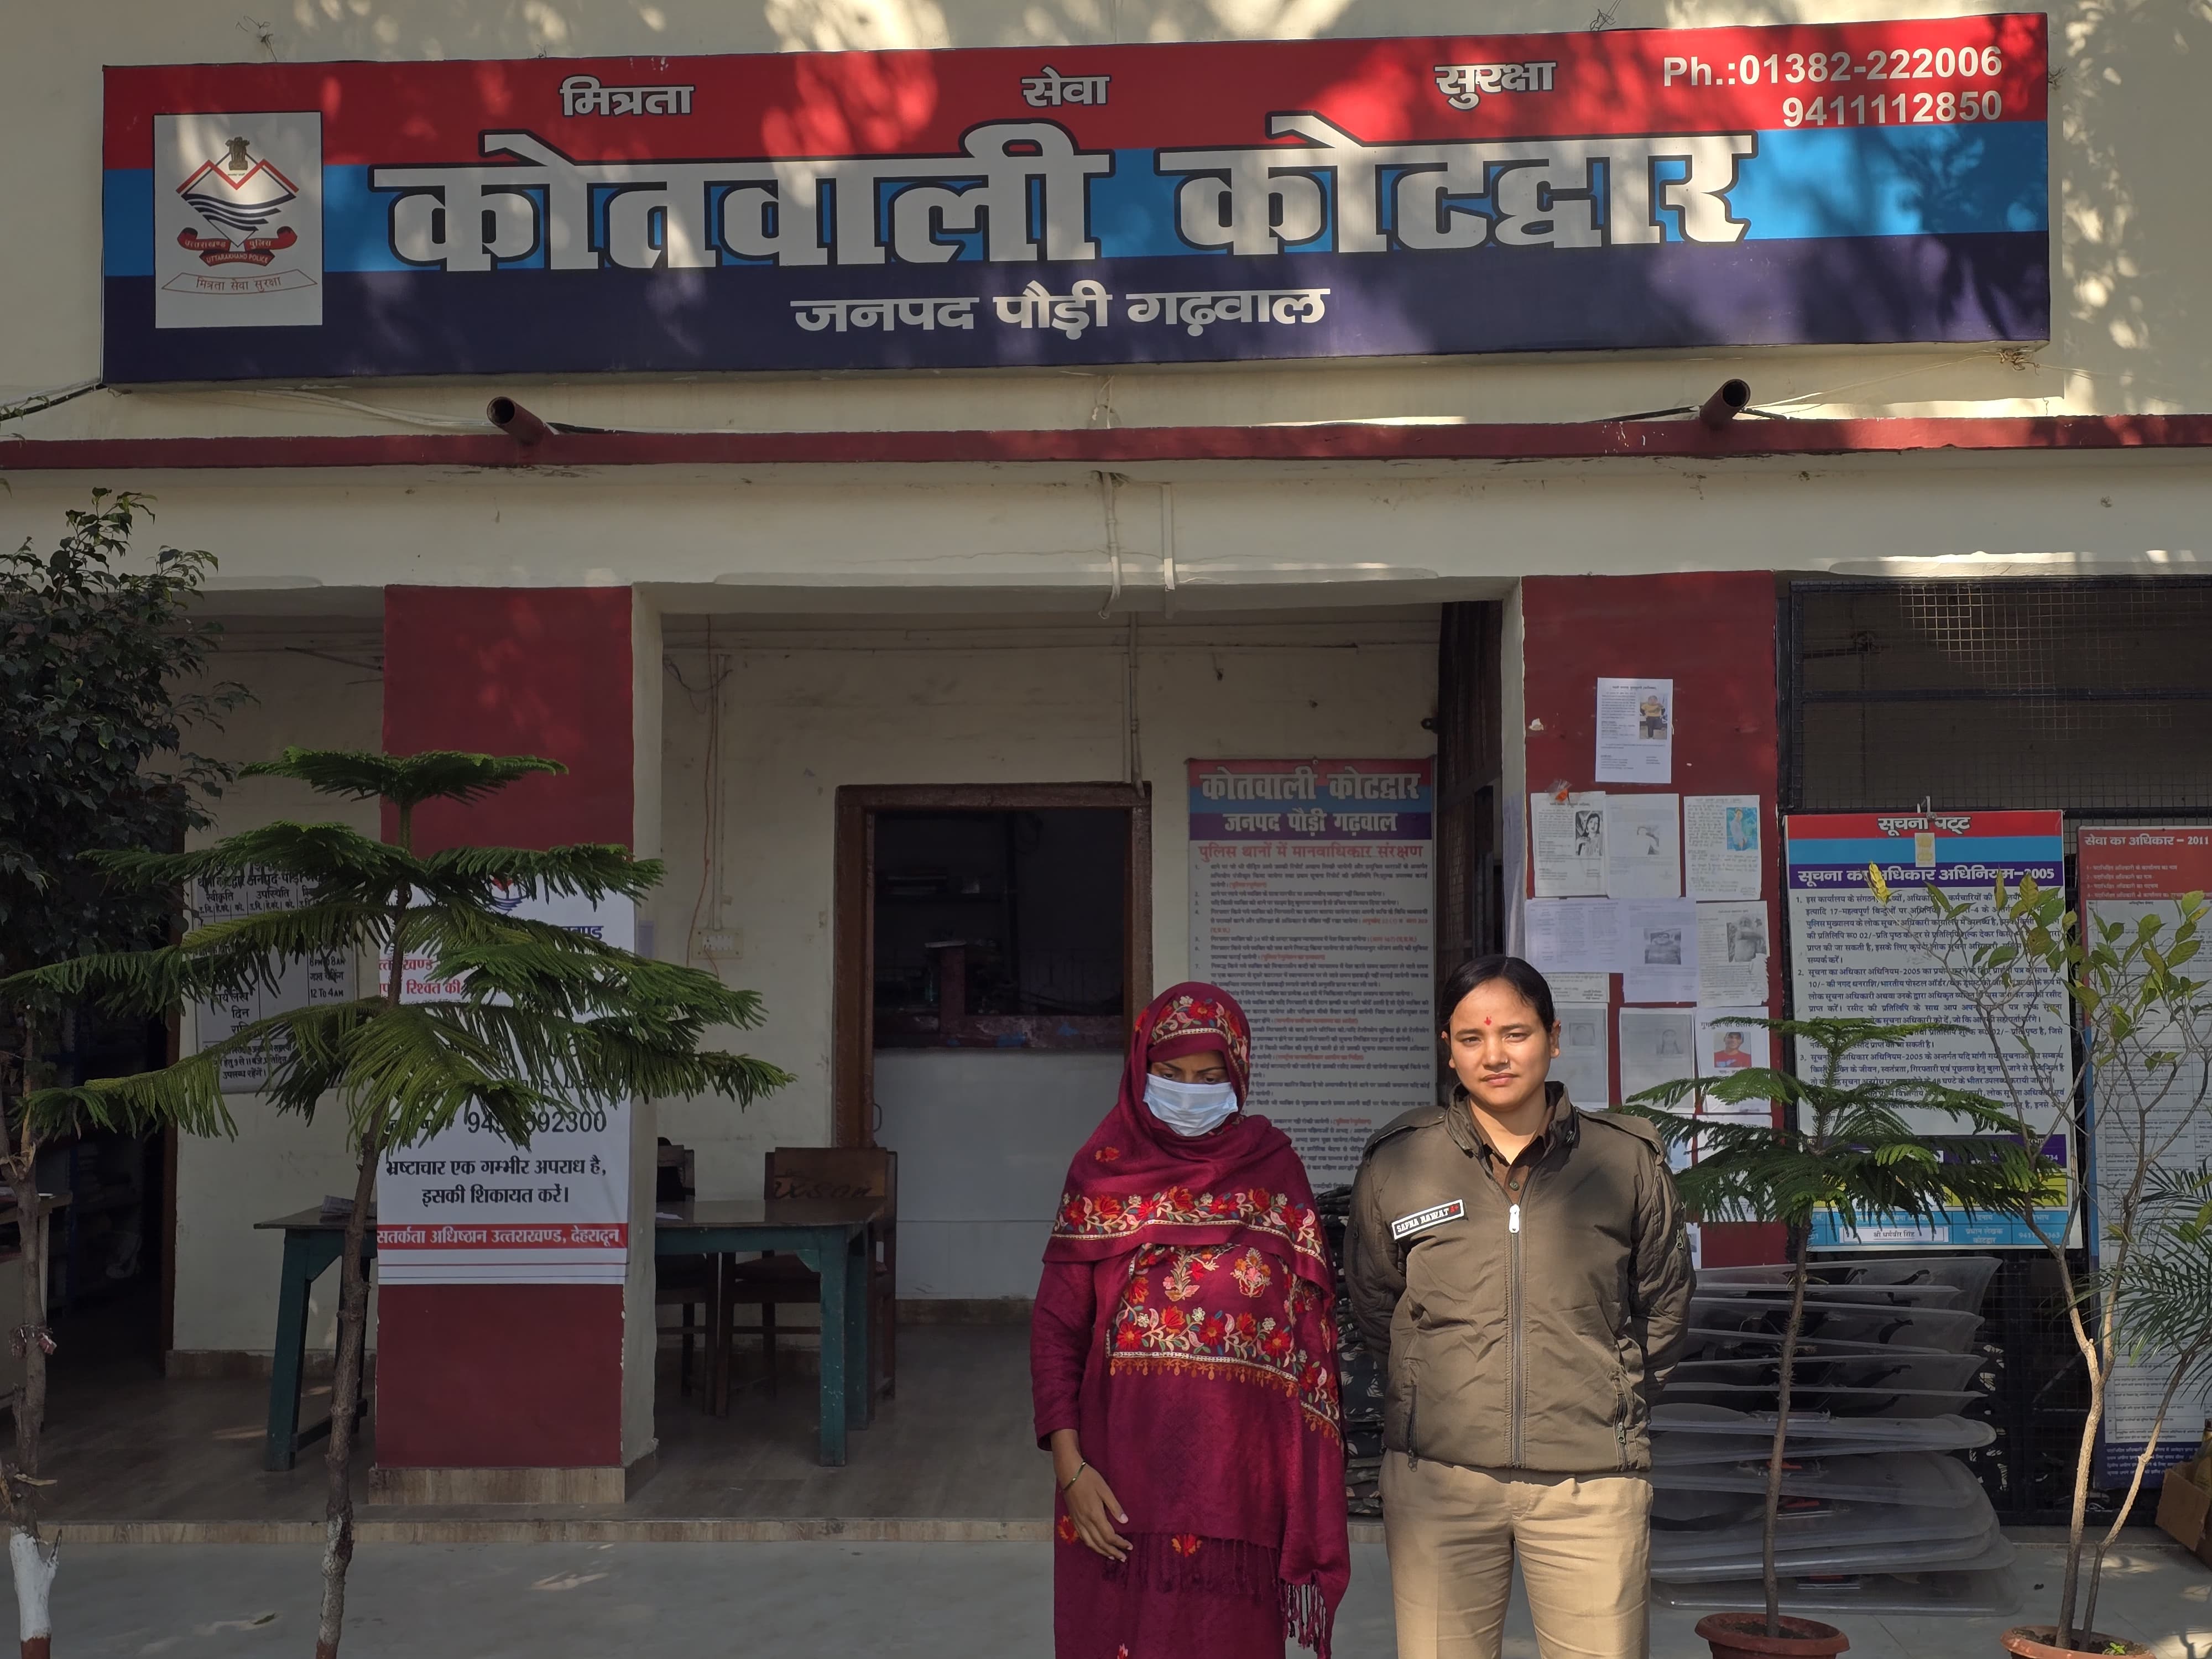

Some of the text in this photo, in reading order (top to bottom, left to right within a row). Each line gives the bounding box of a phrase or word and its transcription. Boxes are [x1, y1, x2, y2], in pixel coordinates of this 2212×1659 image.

[1663, 46, 2002, 87] Ph.:01382-222006
[1022, 68, 1109, 107] सेवा
[1436, 60, 1556, 109] सुरक्षा
[561, 76, 695, 115] मित्रता
[1782, 90, 2002, 127] 9411112850
[374, 114, 1756, 271] कोतवाली कोटद्वार
[249, 253, 269, 263] POLICE
[196, 277, 281, 292] मित्रता सेवा सुरक्षा
[791, 279, 1330, 340] जनपद पौड़ी गढ़वाल
[1199, 766, 1421, 800] कोतवाली कोटद्वार
[1223, 807, 1399, 837] जनपद पौड़ी गढ़वाल
[1878, 817, 1928, 836] सूचना
[2084, 833, 2209, 846] सेवा का अधिकार 2011
[1198, 841, 1424, 862] पुलिस थानों में मानवाधिकार संरक्षण
[1798, 870, 1842, 888] सूचना
[1805, 896, 1816, 905] इस
[1817, 894, 1846, 903] कार्यालय
[1847, 894, 1855, 902] के
[1948, 892, 1982, 901] कर्मचारियों
[1983, 892, 1992, 901] की
[1806, 907, 1827, 916] इत्यादि
[1806, 919, 1825, 928] पुलिस
[1827, 920, 1854, 928] मुख्यालय
[1864, 919, 1880, 927] लोक
[1806, 930, 1816, 939] की
[1817, 930, 1844, 939] प्रतिलिपि
[1979, 930, 1994, 938] देकर
[1823, 943, 1833, 951] की
[1845, 942, 1864, 951] सकती
[1866, 942, 1874, 952] है,
[1875, 942, 1892, 952] इसके
[1894, 942, 1907, 952] लिए
[1808, 968, 1827, 977] सूचना
[1839, 967, 1866, 975] अधिकार
[1867, 967, 1921, 975] अधिनियम-2005
[406, 979, 462, 995] रिश्वत की
[1827, 979, 1836, 987] की
[311, 989, 317, 998] 12
[328, 988, 344, 998] 4AM
[1808, 992, 1824, 1000] लोक
[1825, 993, 1844, 1001] सूचना
[1845, 991, 1874, 1000] अधिकारी
[1897, 991, 1912, 999] उनके
[1913, 992, 1926, 1000] द्वारा
[1928, 992, 1954, 1001] अधिकृत
[2046, 990, 2062, 999] रसीद
[231, 1005, 250, 1019] दिन
[1808, 1004, 1823, 1013] प्राप्त
[1846, 1003, 1864, 1013] रसीद
[1867, 1003, 1877, 1012] की
[1882, 1003, 1909, 1012] प्रतिलिपि
[1913, 1003, 1921, 1011] के
[1883, 1015, 1932, 1025] सूचना अधिकारी
[2048, 1027, 2063, 1035] जिसे
[1906, 1039, 1925, 1048] सकती
[1924, 1052, 1932, 1060] के
[1958, 1051, 1970, 1060] यदि
[1971, 1051, 1986, 1060] मांगी
[223, 1070, 246, 1079] उपलब्ध
[1850, 1064, 1858, 1072] के
[1859, 1064, 1880, 1074] जीवन,
[1910, 1063, 1938, 1073] गिरफ्तारी
[1940, 1063, 1950, 1072] एवं
[1952, 1065, 1975, 1074] पूछताछ
[1976, 1063, 1986, 1073] हेतु
[2059, 1063, 2064, 1072] है
[2034, 1100, 2049, 1109] इनसे
[385, 1155, 607, 1176] भ्रष्टाचार एक गम्भीर अपराध है,
[421, 1183, 465, 1208] इसकी
[470, 1183, 533, 1204] शिकायत
[1420, 1208, 1449, 1224] RAWAT
[377, 1225, 620, 1246] सतर्कता अधिष्ठान उत्तराखण्ड, देहरादून
